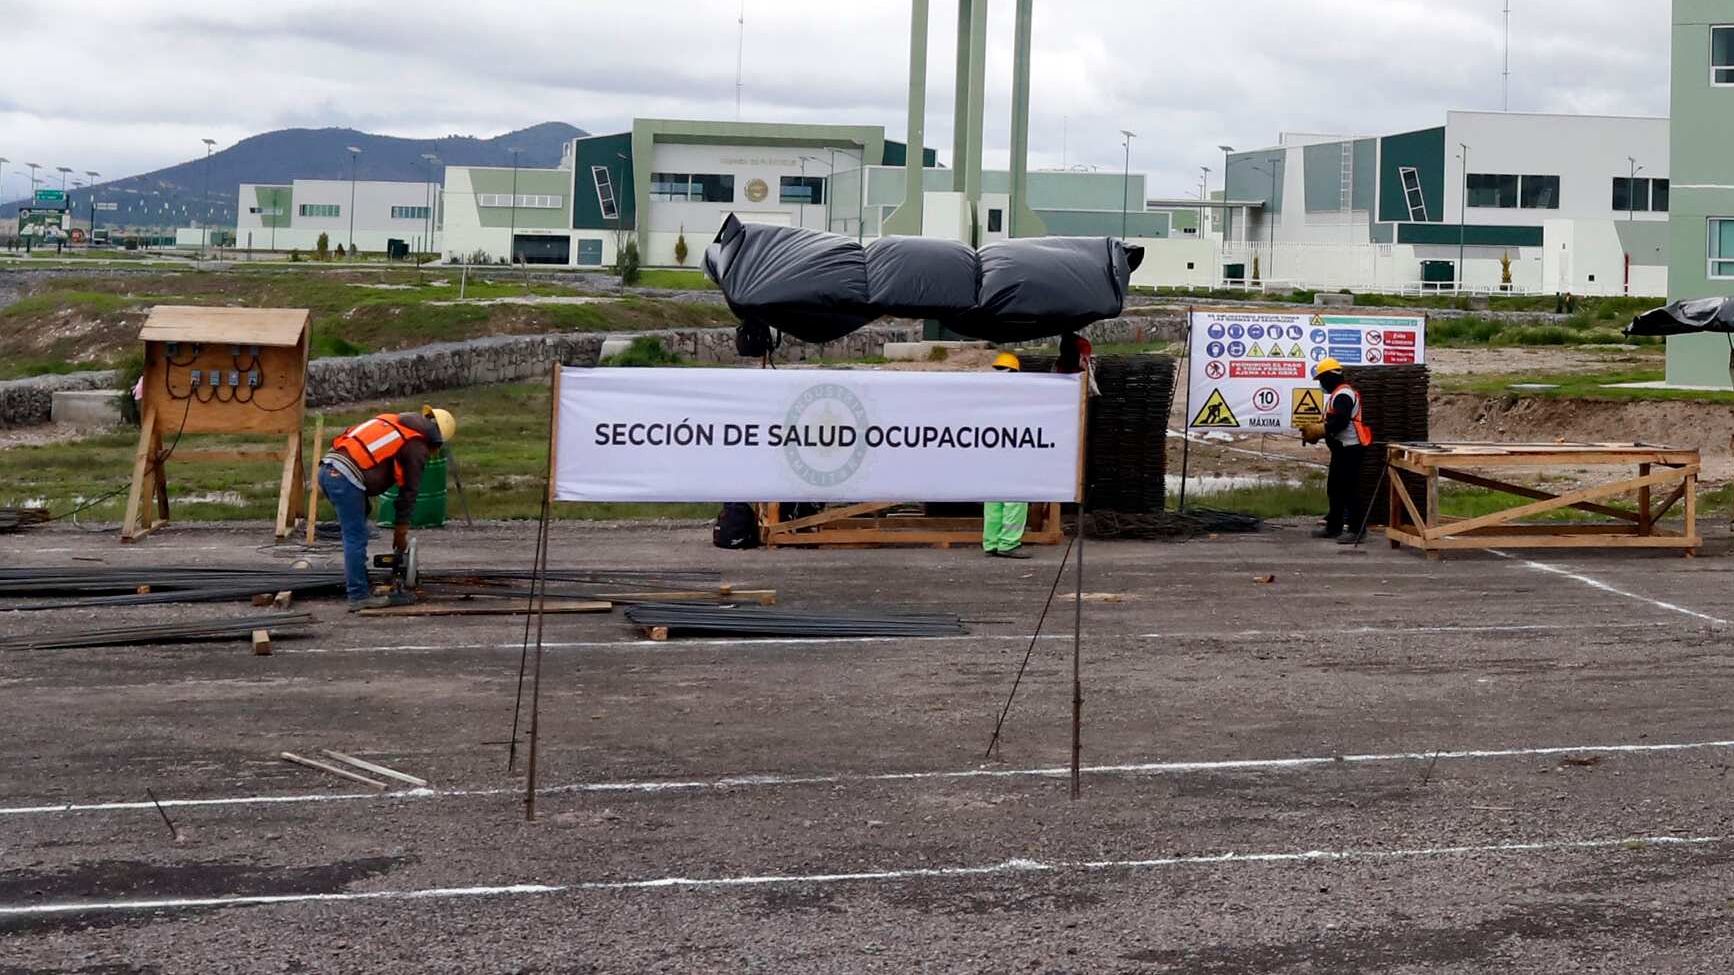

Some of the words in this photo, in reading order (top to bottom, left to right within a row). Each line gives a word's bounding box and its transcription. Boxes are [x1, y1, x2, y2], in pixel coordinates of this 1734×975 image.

[1258, 391, 1274, 405] 10
[1248, 415, 1281, 427] MÁXIMA
[594, 417, 714, 446] SECCIÓN
[722, 424, 760, 446] DE
[767, 424, 857, 447] SALUD
[864, 425, 1056, 449] OCUPACIONAL.
